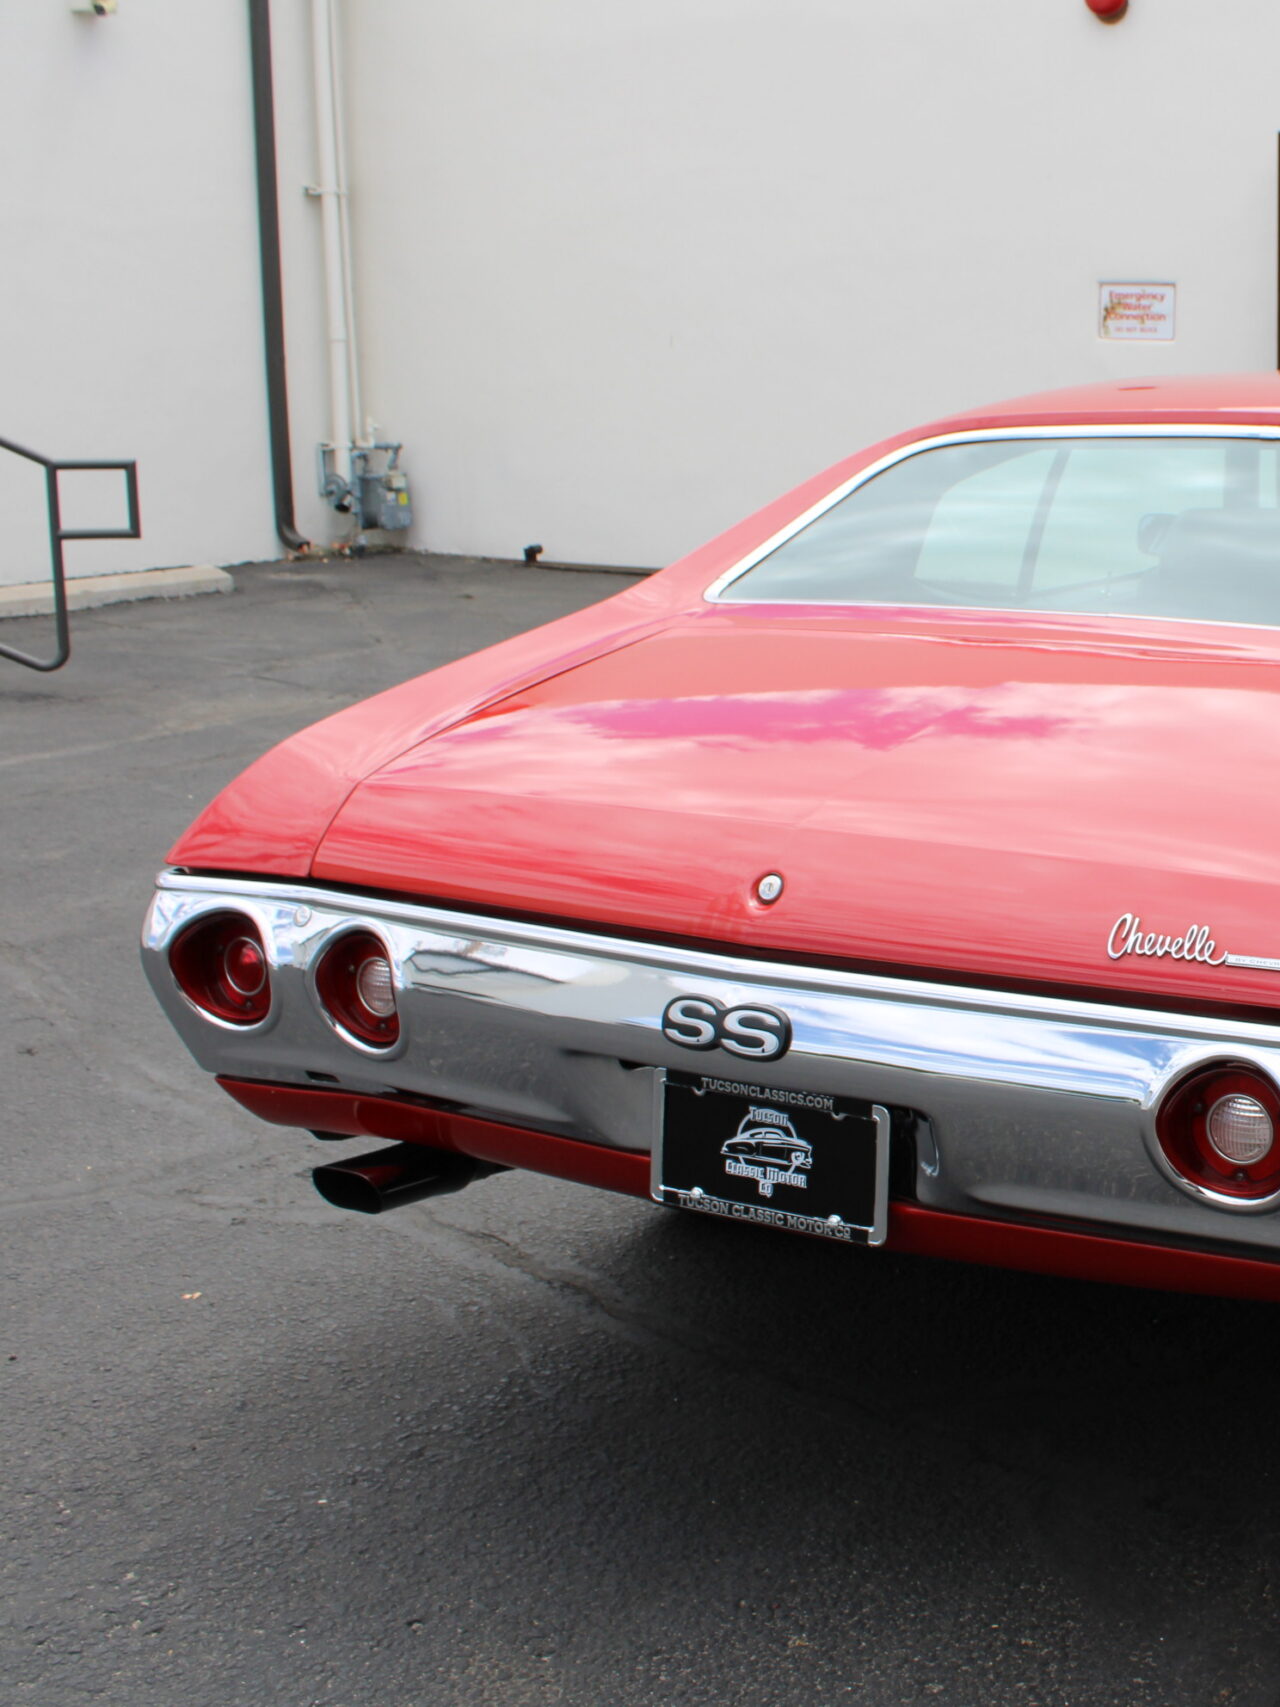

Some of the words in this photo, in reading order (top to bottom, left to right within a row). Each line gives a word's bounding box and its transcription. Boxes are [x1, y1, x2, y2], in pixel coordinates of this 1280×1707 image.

[1106, 912, 1227, 966] Chevelle
[663, 996, 785, 1059] SS
[701, 1077, 834, 1111] TUCSONCLASSICS.COM
[678, 1193, 729, 1215] TUCSON
[732, 1203, 784, 1225] CLASSIC
[787, 1214, 832, 1236] MOTOR
